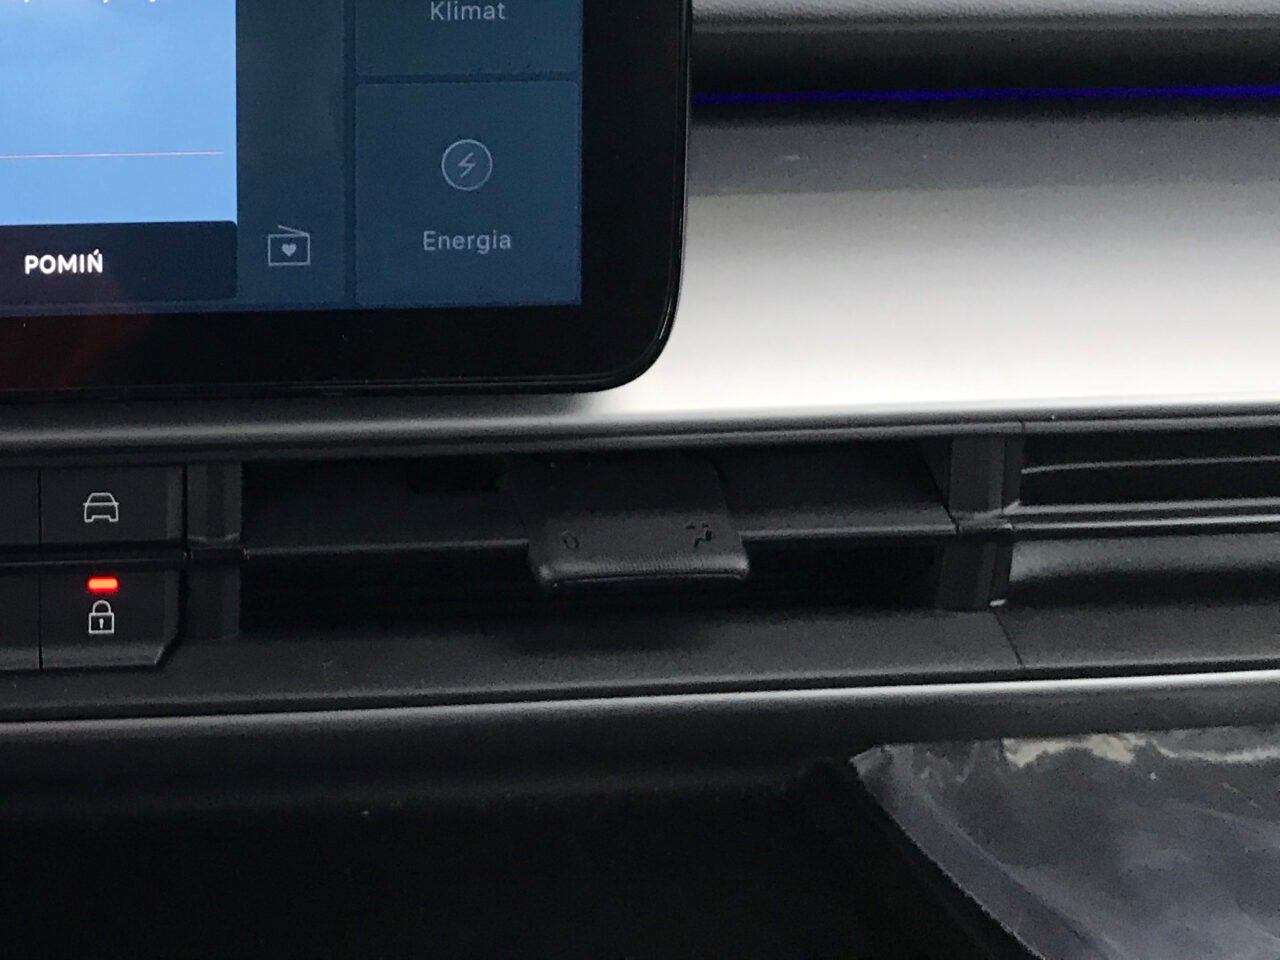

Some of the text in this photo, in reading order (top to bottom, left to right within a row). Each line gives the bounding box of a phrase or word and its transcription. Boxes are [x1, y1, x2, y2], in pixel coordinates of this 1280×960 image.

[430, 0, 507, 22] Klimat
[422, 230, 513, 255] Energia
[24, 249, 104, 275] POMIŃ
